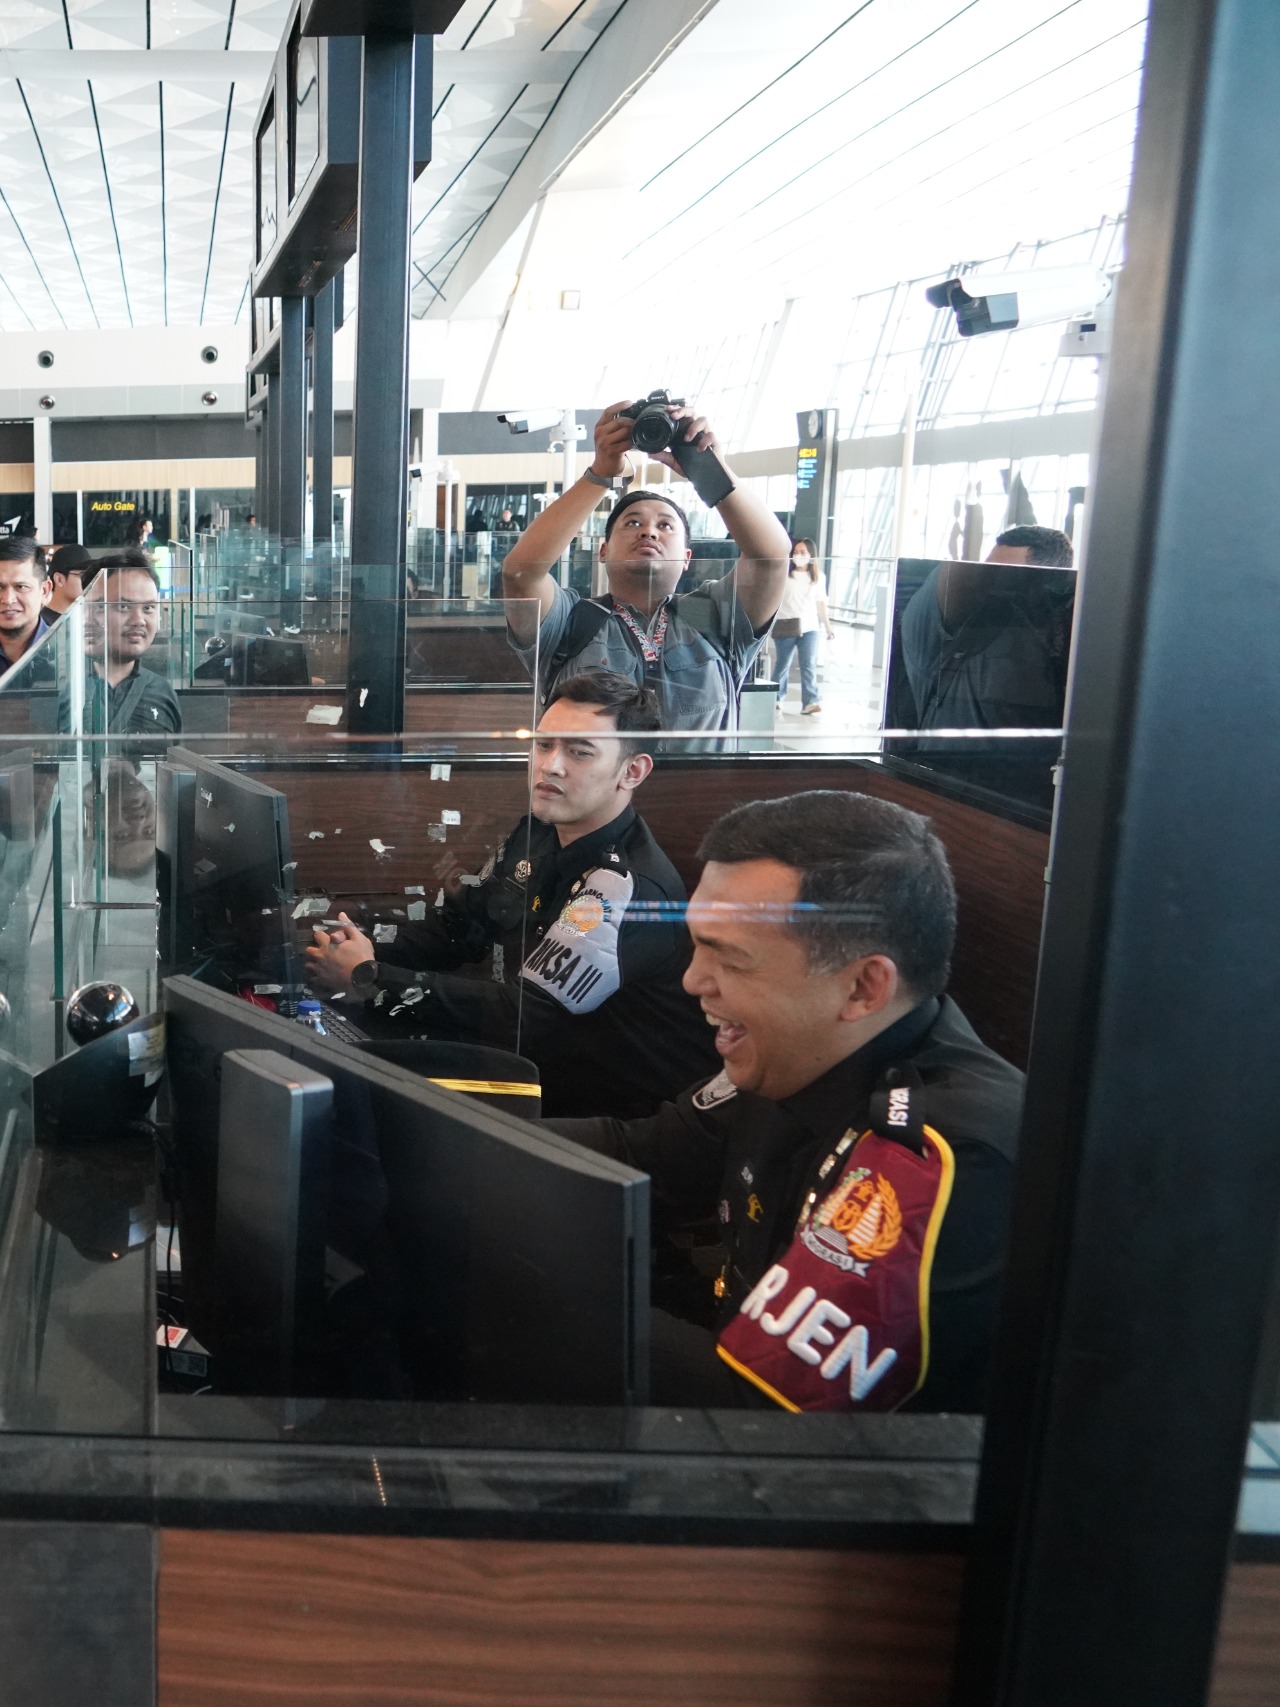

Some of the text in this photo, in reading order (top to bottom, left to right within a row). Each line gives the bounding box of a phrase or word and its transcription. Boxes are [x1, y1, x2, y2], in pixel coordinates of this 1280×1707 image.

[91, 501, 135, 511] Auto Gate
[740, 1263, 898, 1401] RJEN
